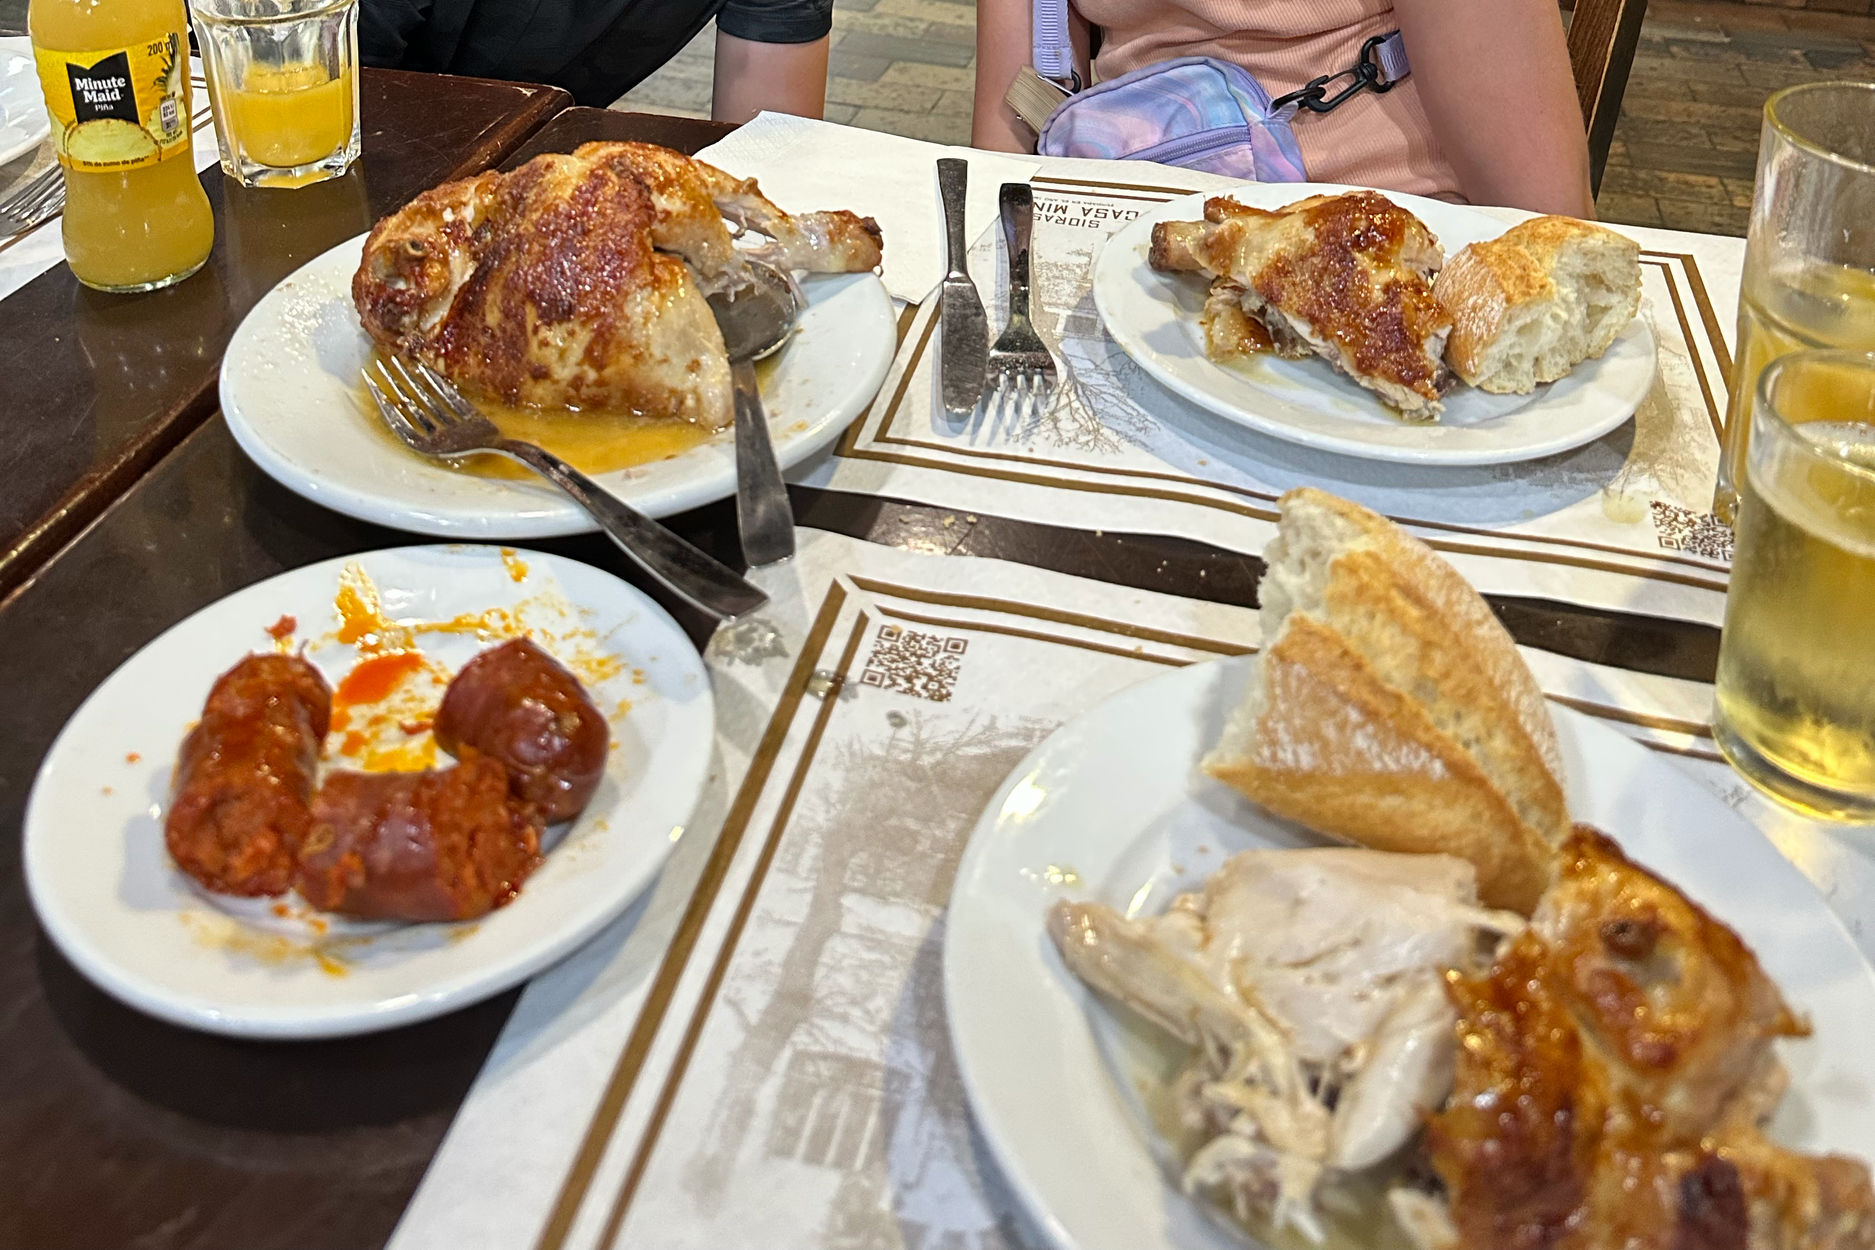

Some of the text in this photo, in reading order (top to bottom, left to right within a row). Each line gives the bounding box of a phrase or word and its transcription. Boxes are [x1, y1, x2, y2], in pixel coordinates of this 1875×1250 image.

[147, 41, 164, 56] 200
[74, 76, 126, 91] Minute
[83, 88, 122, 103] Maid
[94, 103, 114, 112] Piña
[1033, 201, 1139, 221] CASA MIN
[1033, 212, 1101, 229] SIDRAS
